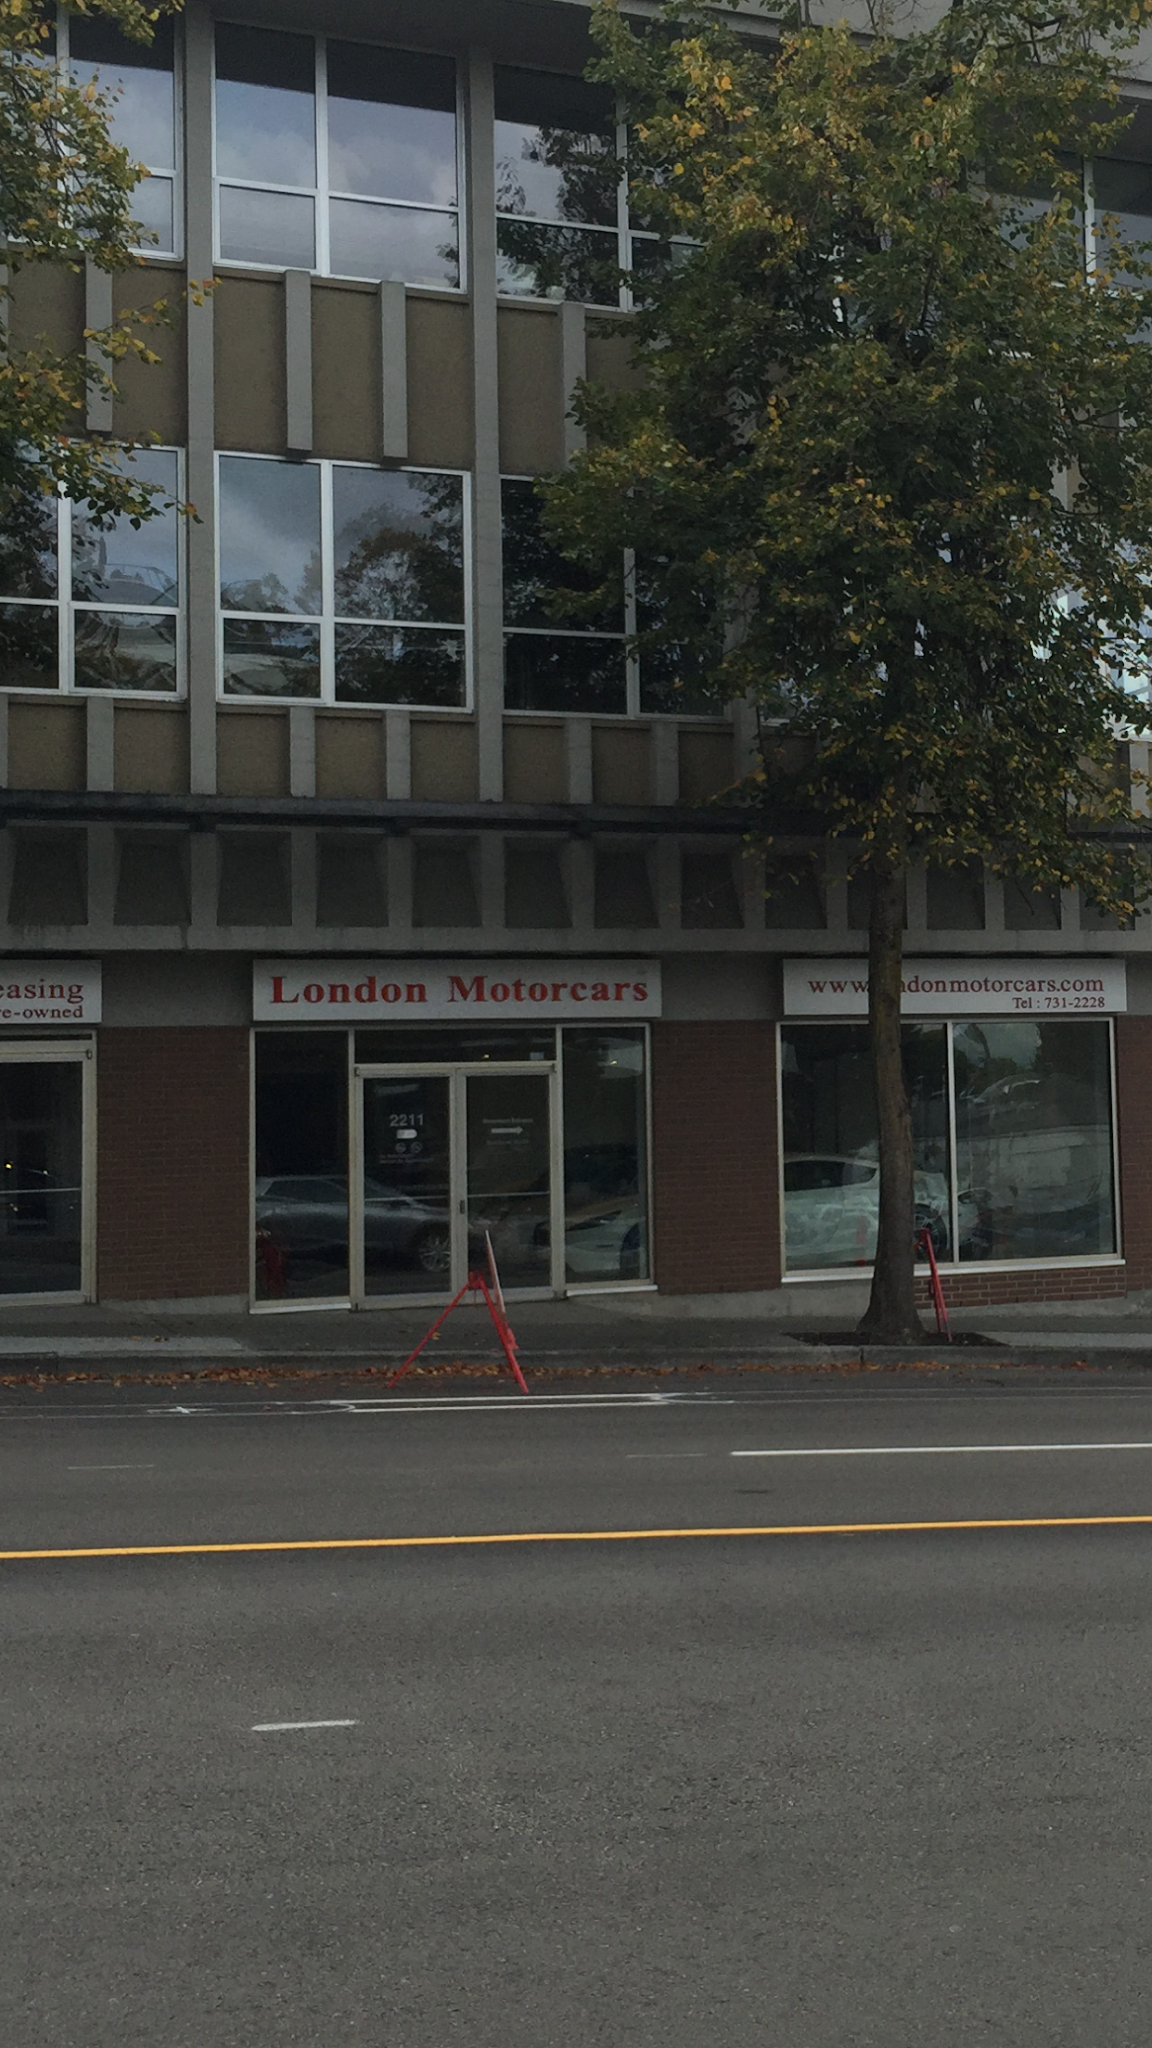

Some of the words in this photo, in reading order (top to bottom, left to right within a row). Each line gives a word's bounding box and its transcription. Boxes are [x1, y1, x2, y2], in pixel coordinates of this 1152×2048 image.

[270, 975, 427, 1004] London
[447, 975, 649, 1003] Motorcars
[1044, 997, 1105, 1009] 731-2228
[0, 1005, 83, 1019] e-owned
[390, 1113, 424, 1127] 2211
